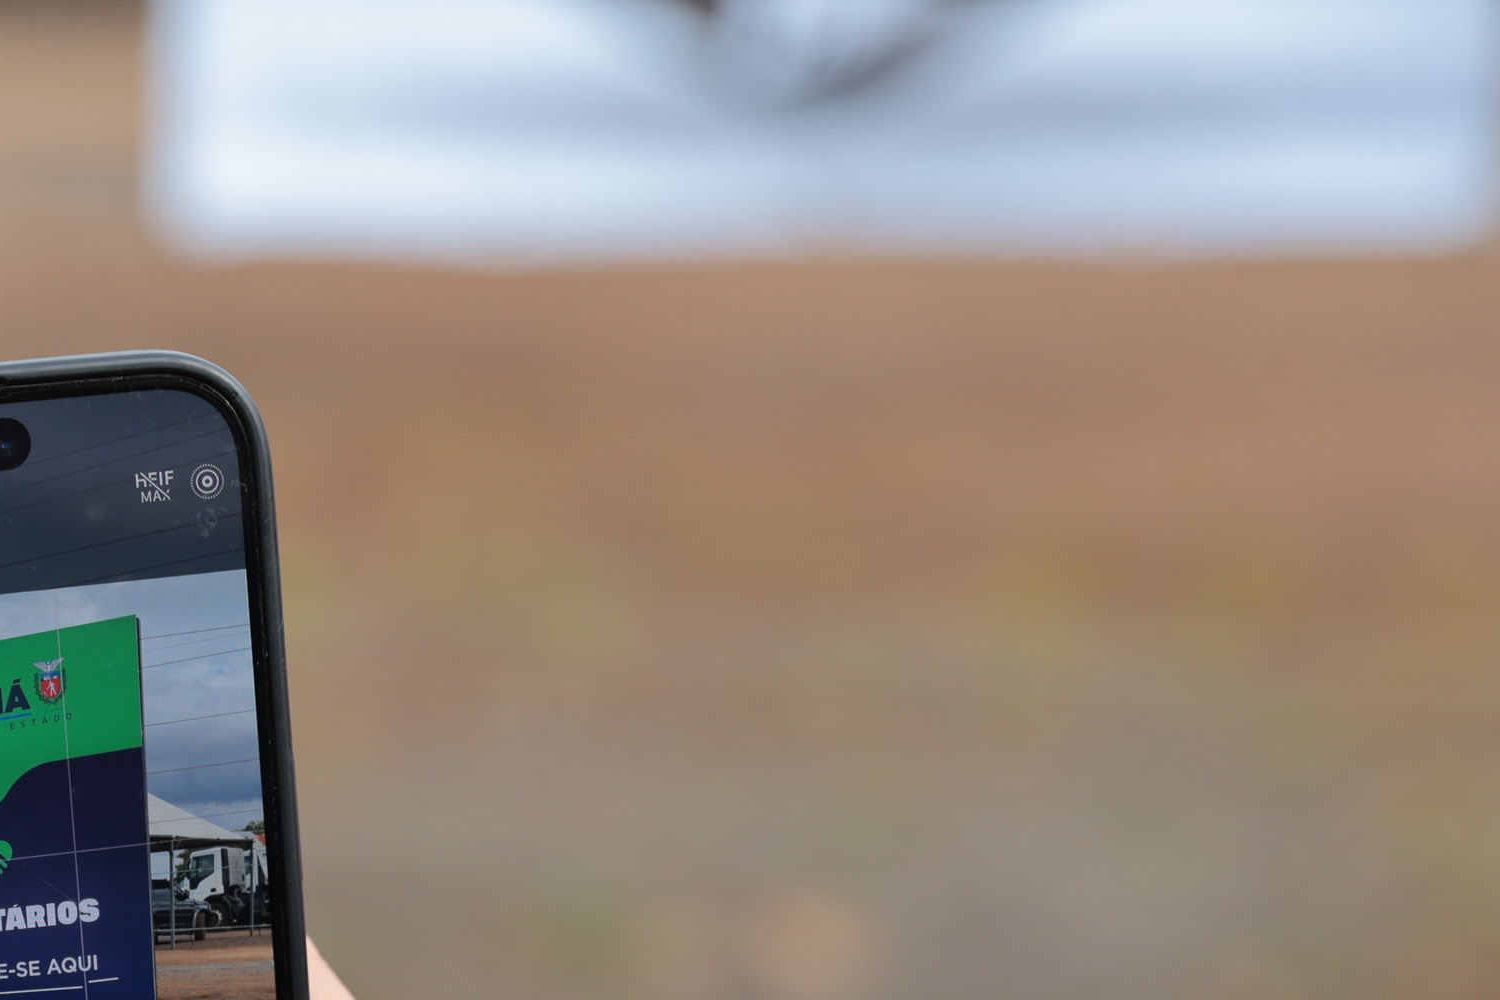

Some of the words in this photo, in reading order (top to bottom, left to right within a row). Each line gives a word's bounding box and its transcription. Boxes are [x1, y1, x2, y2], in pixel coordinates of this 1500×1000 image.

[135, 470, 174, 488] HEIF
[10, 712, 73, 730] ESTADO
[47, 954, 99, 976] AQUI
